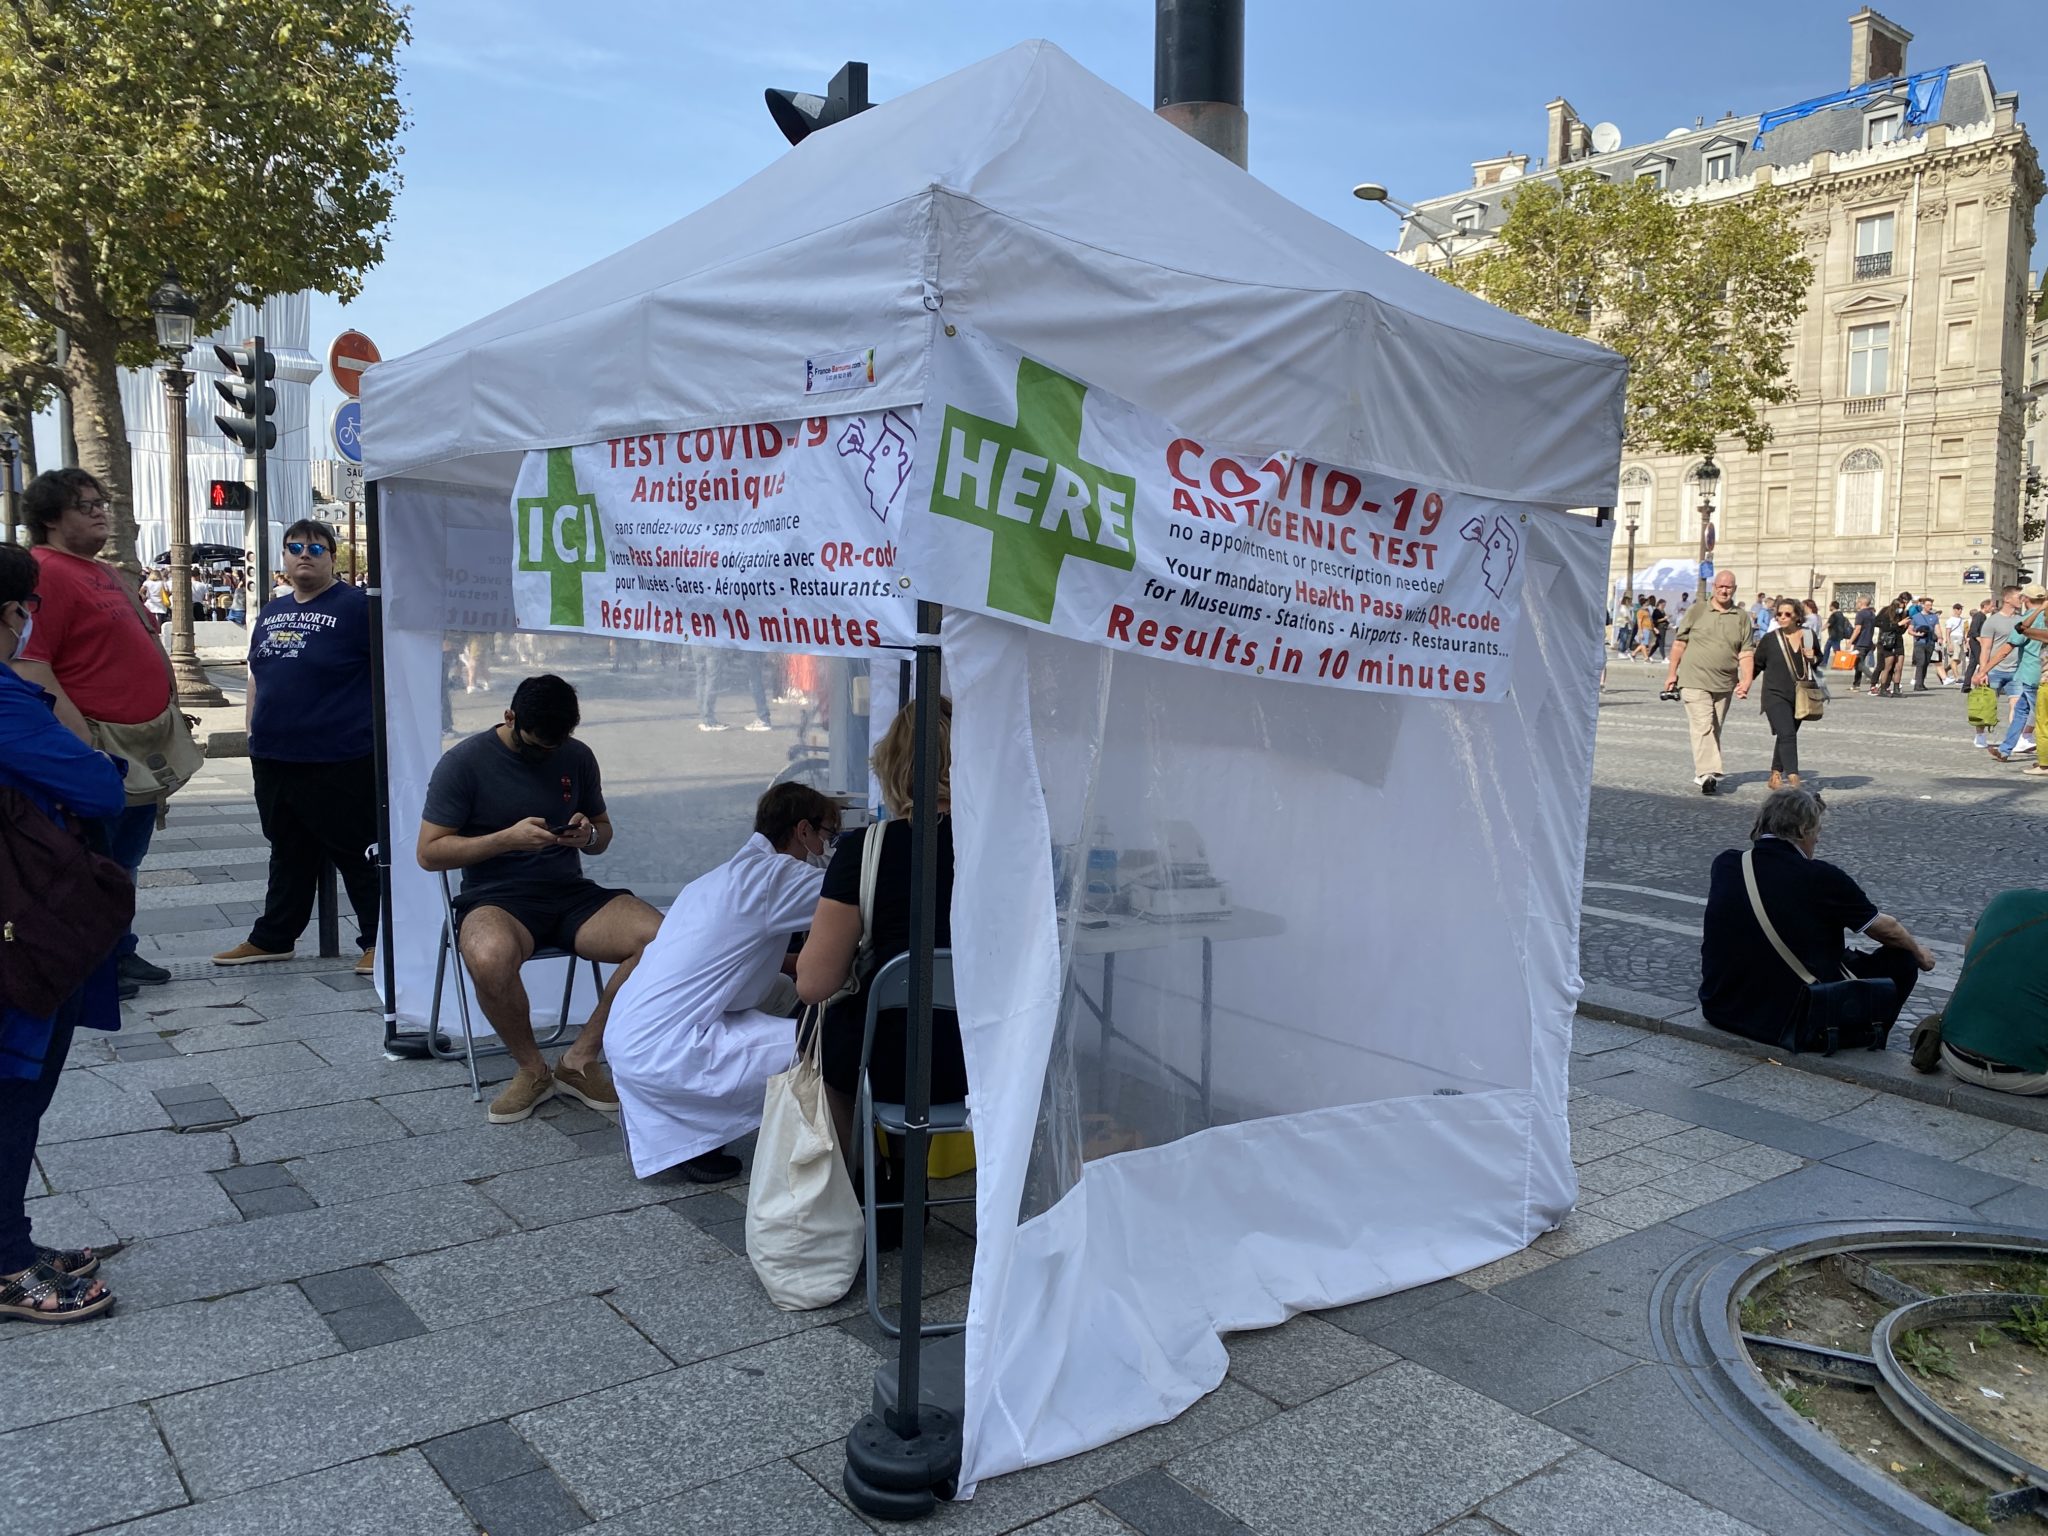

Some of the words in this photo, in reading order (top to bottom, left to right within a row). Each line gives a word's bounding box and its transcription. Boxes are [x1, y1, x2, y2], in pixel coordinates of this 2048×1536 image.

[347, 467, 363, 477] SAU
[607, 433, 666, 468] TEST
[631, 468, 785, 511] Antigénique
[943, 426, 1130, 552] HERE
[1166, 438, 1443, 535] COVID-19
[528, 503, 596, 563] ICI
[615, 521, 633, 535] sans
[636, 518, 702, 536] rendez-vous
[712, 522, 738, 536] sans
[741, 514, 800, 535] ordonnance
[1172, 488, 1357, 555] ANTIGENIC
[1369, 532, 1438, 570] TEST
[610, 549, 631, 566] Votre
[628, 545, 653, 567] Pass
[656, 544, 719, 568] Sanitaire
[721, 549, 780, 573] obligatoire
[783, 550, 815, 568] avec
[820, 539, 897, 572] QR-cod
[1169, 523, 1193, 540] no
[1200, 529, 1288, 566] appointment
[1292, 554, 1307, 569] or
[1311, 557, 1391, 586] prescription
[1397, 576, 1445, 594] needed
[615, 576, 636, 593] pour
[638, 574, 669, 592] Musées
[676, 576, 704, 594] Gares
[715, 577, 776, 600] Aéroports
[1165, 556, 1212, 582] Your
[1215, 569, 1292, 604] mandatory
[1295, 580, 1354, 612] Health
[1360, 593, 1403, 620] Pass
[1405, 606, 1427, 624] with
[1428, 604, 1501, 633] QR-code
[261, 612, 298, 627] MARINE
[297, 612, 337, 628] NORTH
[266, 622, 289, 631] COAST
[287, 622, 322, 632] CLIMATE
[601, 599, 683, 635] Résultat
[691, 612, 716, 638] en
[723, 608, 750, 640] 10
[758, 607, 881, 647] minutes
[1143, 578, 1176, 602] for
[1180, 589, 1262, 621] Museums
[1275, 608, 1335, 635] Stations
[1350, 622, 1402, 645] Airports
[1412, 631, 1509, 657] Restaurants...
[1106, 603, 1259, 668] Results
[1269, 636, 1304, 674] in
[1318, 647, 1349, 680] 10
[1358, 653, 1487, 694] minutes
